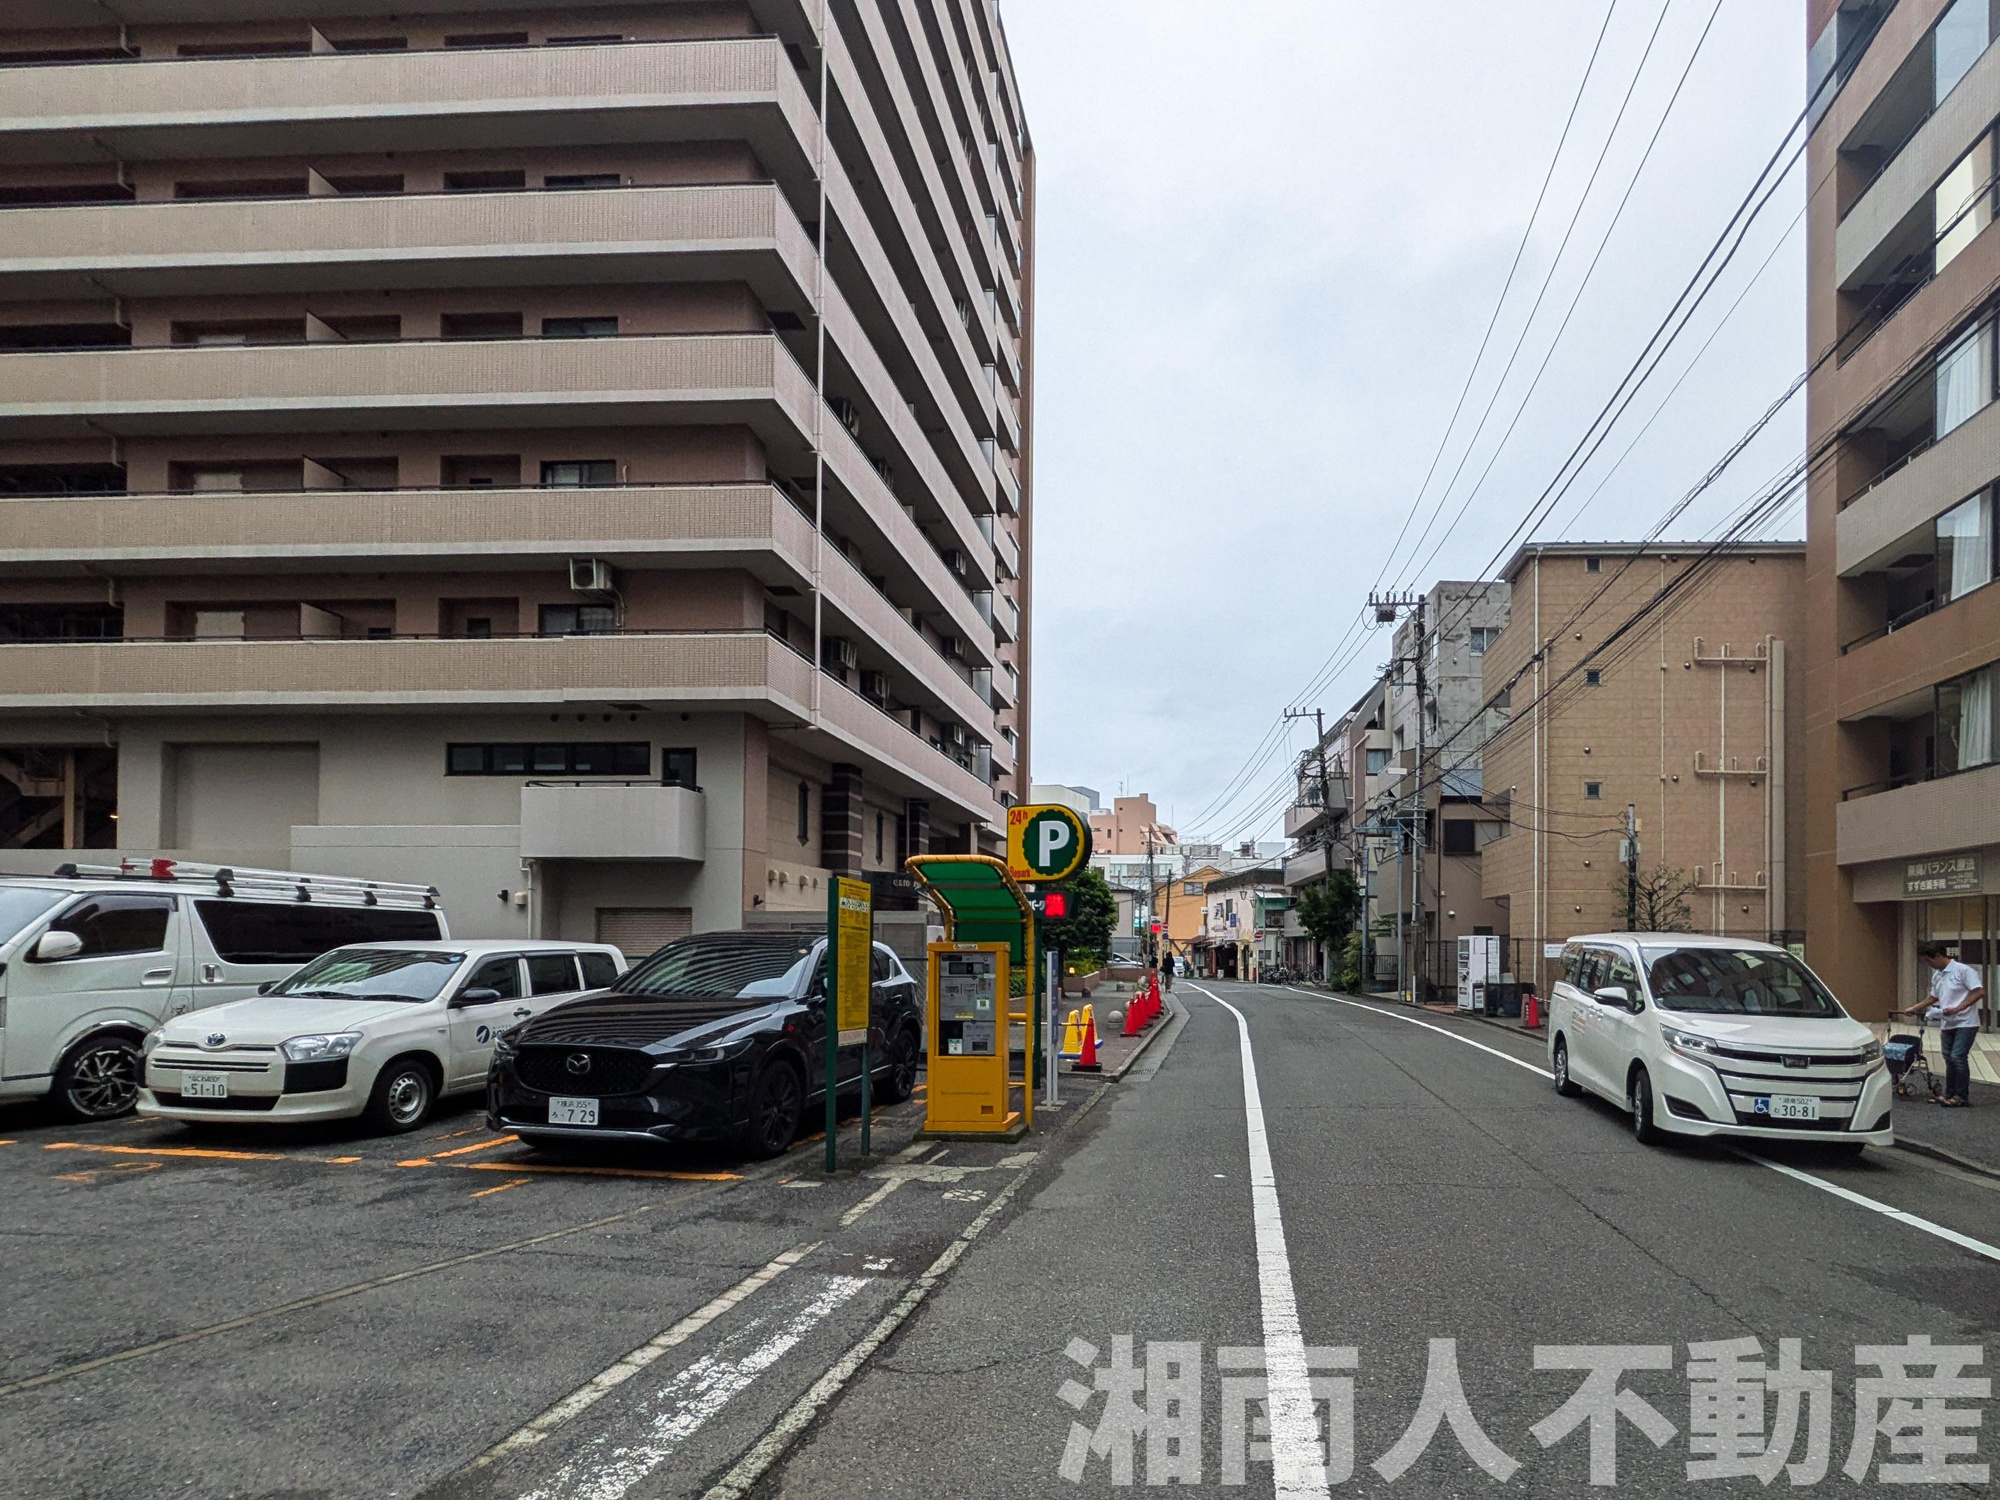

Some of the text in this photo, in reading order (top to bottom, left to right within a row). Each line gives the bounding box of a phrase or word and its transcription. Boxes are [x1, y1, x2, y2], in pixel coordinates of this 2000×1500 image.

[1039, 820, 1070, 867] P
[191, 1083, 225, 1096] 51-10
[1781, 1104, 1815, 1118] 30-81
